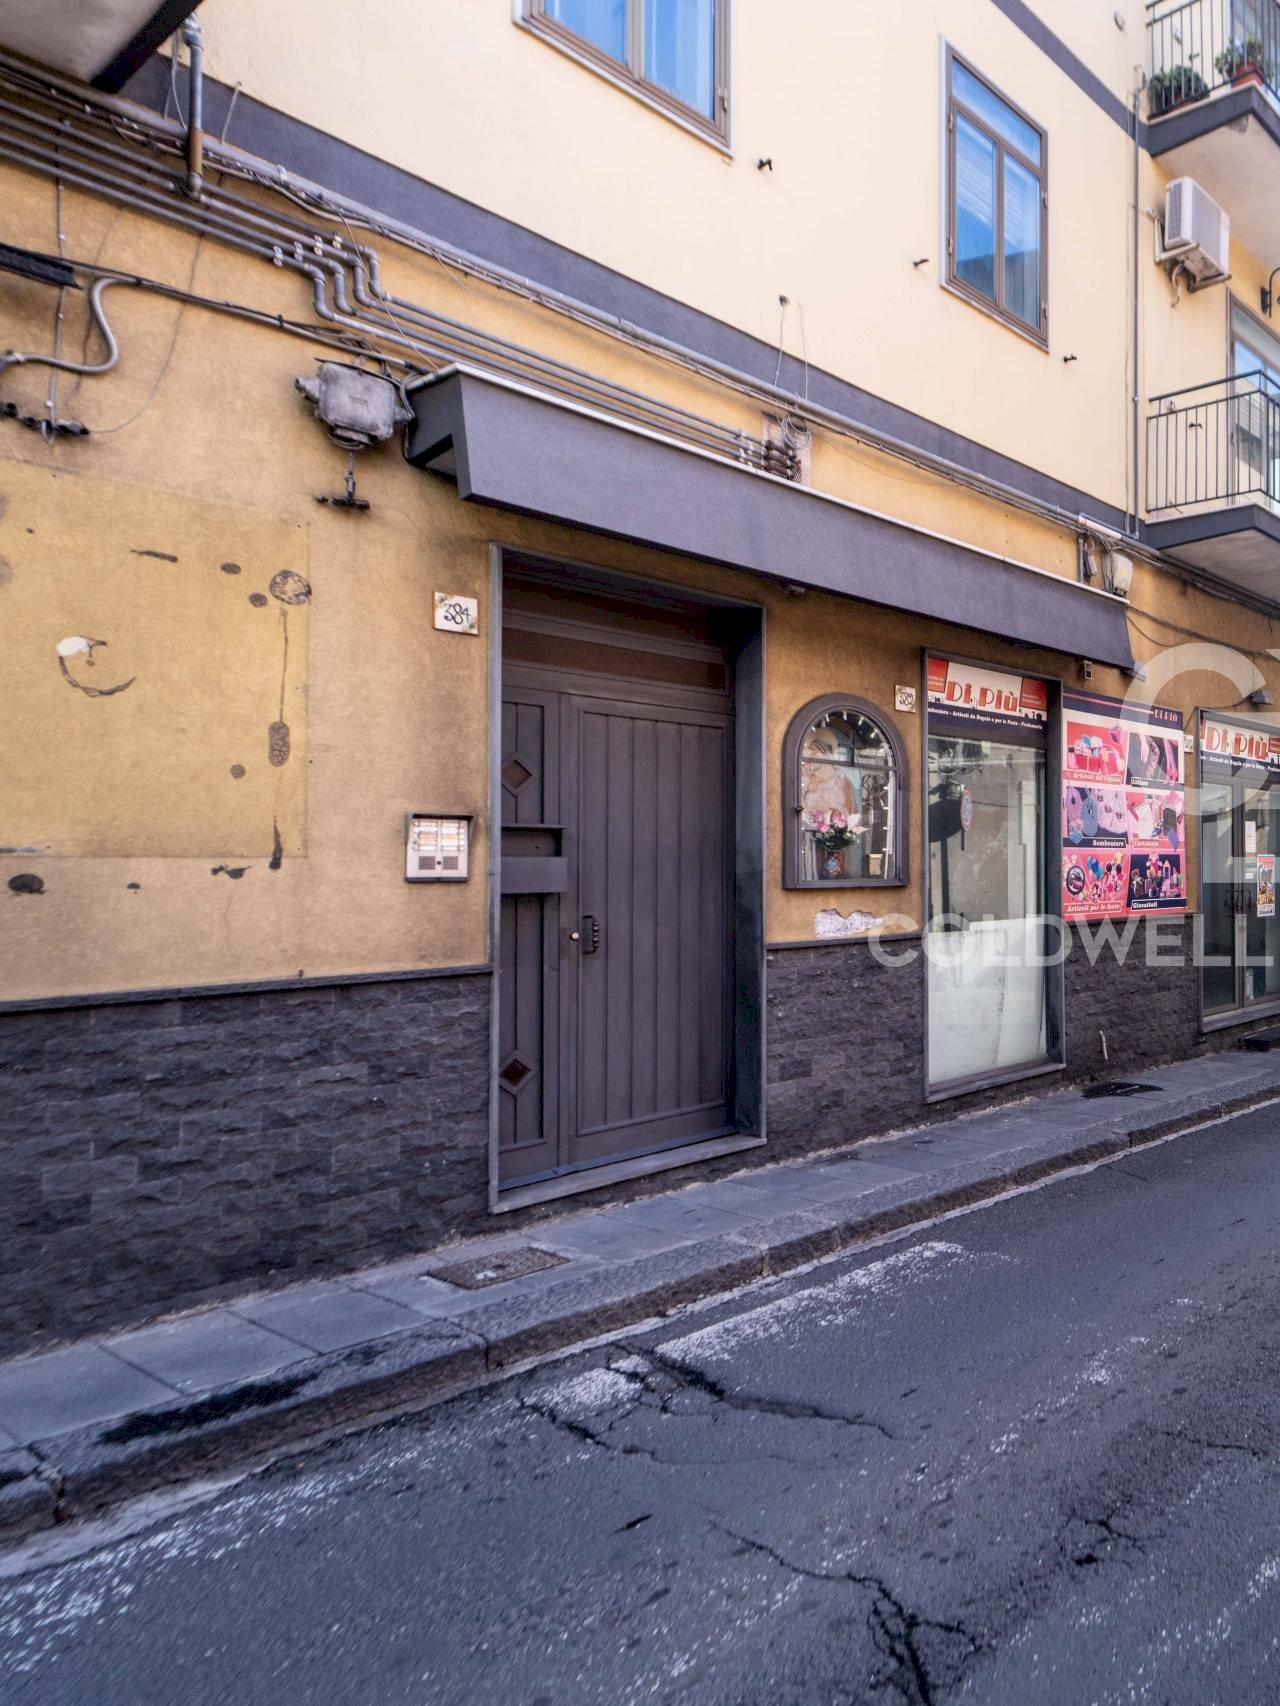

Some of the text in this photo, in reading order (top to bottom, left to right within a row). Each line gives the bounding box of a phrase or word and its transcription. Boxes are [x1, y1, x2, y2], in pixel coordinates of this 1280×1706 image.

[444, 603, 471, 625] 384
[946, 681, 1019, 713] Di Più
[952, 710, 969, 719] Articoli
[1206, 726, 1228, 752] Di
[1233, 732, 1269, 760] Più
[1073, 772, 1094, 780] Articoli
[1093, 839, 1124, 847] Bomboniere
